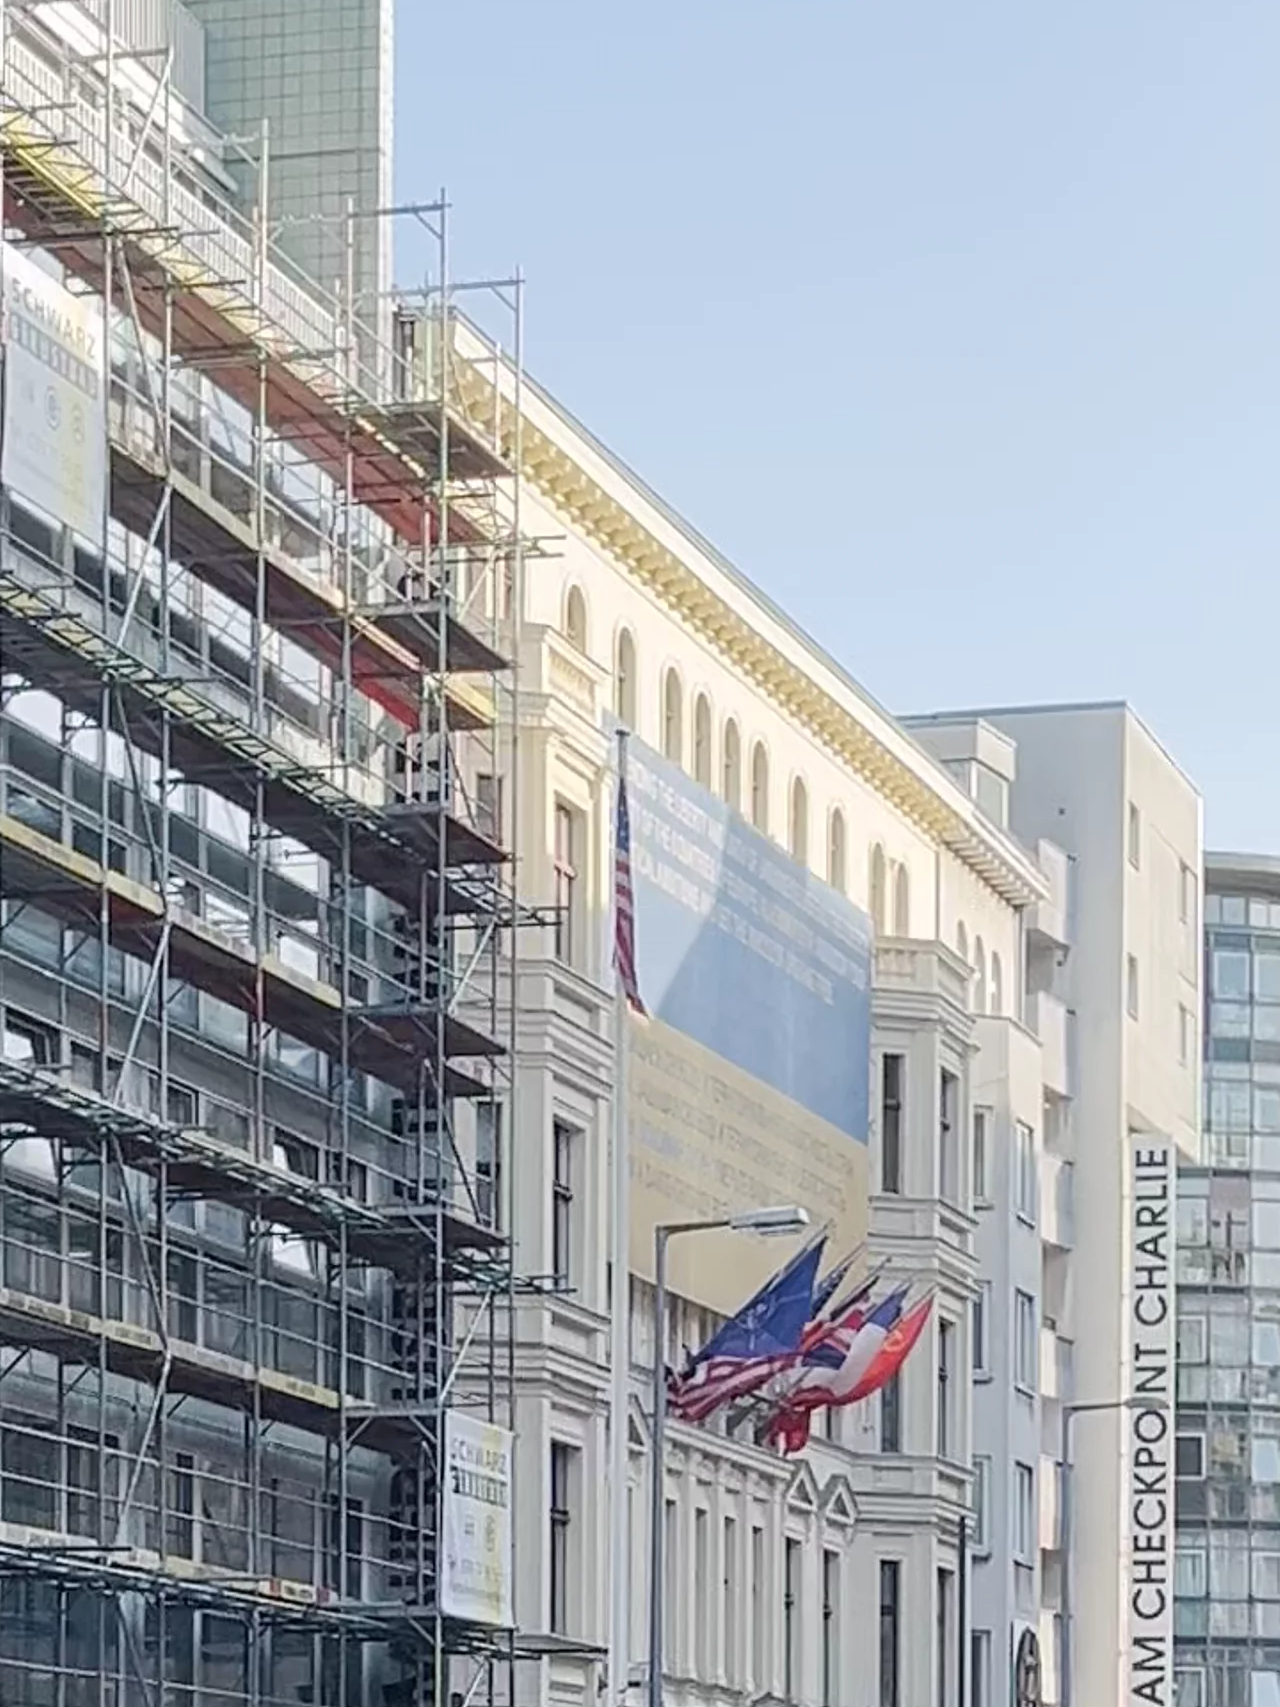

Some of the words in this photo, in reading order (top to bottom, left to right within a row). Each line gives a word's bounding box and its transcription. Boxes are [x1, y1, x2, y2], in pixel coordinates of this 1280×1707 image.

[1134, 1149, 1168, 1327] CHARLIE
[1132, 1343, 1167, 1620] CHECKPONT
[1132, 1637, 1166, 1707] AM
